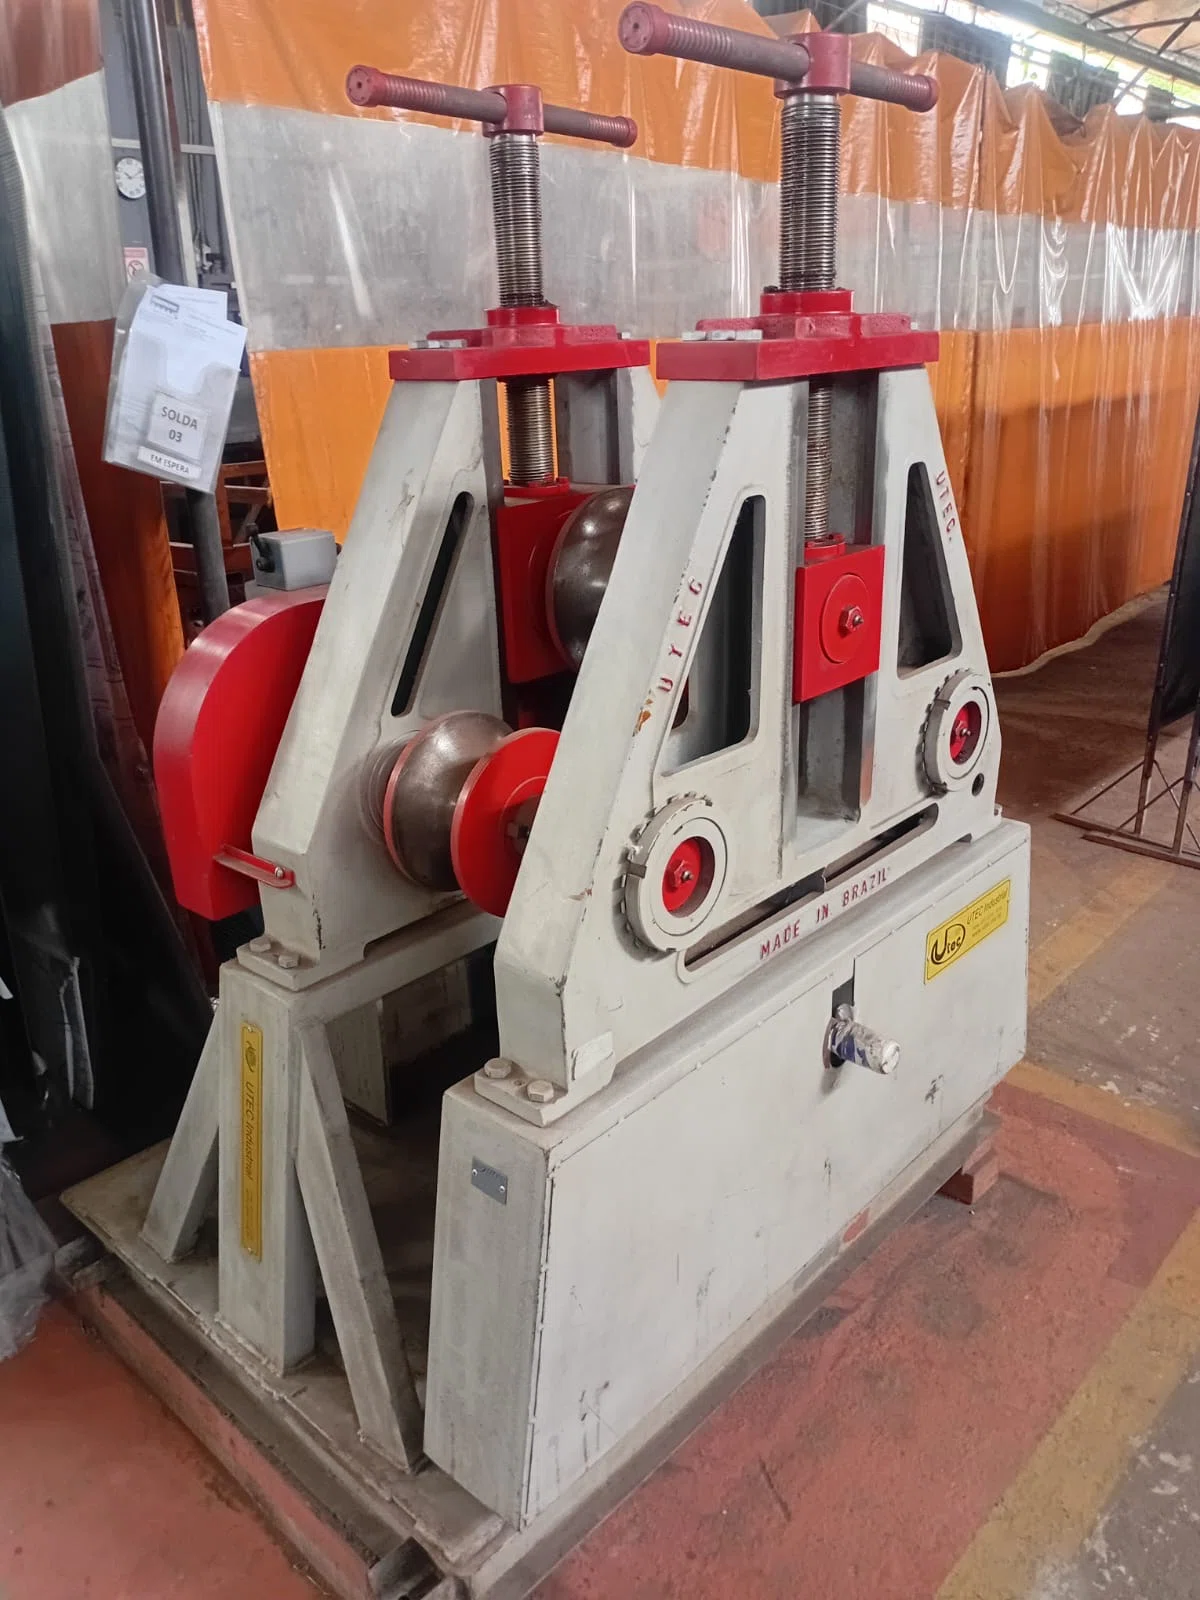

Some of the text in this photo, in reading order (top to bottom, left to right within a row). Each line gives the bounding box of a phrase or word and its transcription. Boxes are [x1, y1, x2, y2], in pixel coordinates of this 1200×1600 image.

[161, 405, 198, 430] SOLDA
[168, 429, 182, 443] 03
[150, 453, 190, 475] EM ESPERA
[936, 470, 956, 533] UTEC
[759, 867, 887, 960] MADE IN BRAZIL
[966, 905, 984, 925] UTEC
[244, 1080, 254, 1121] UTEC
[244, 1121, 254, 1181] Industrial
